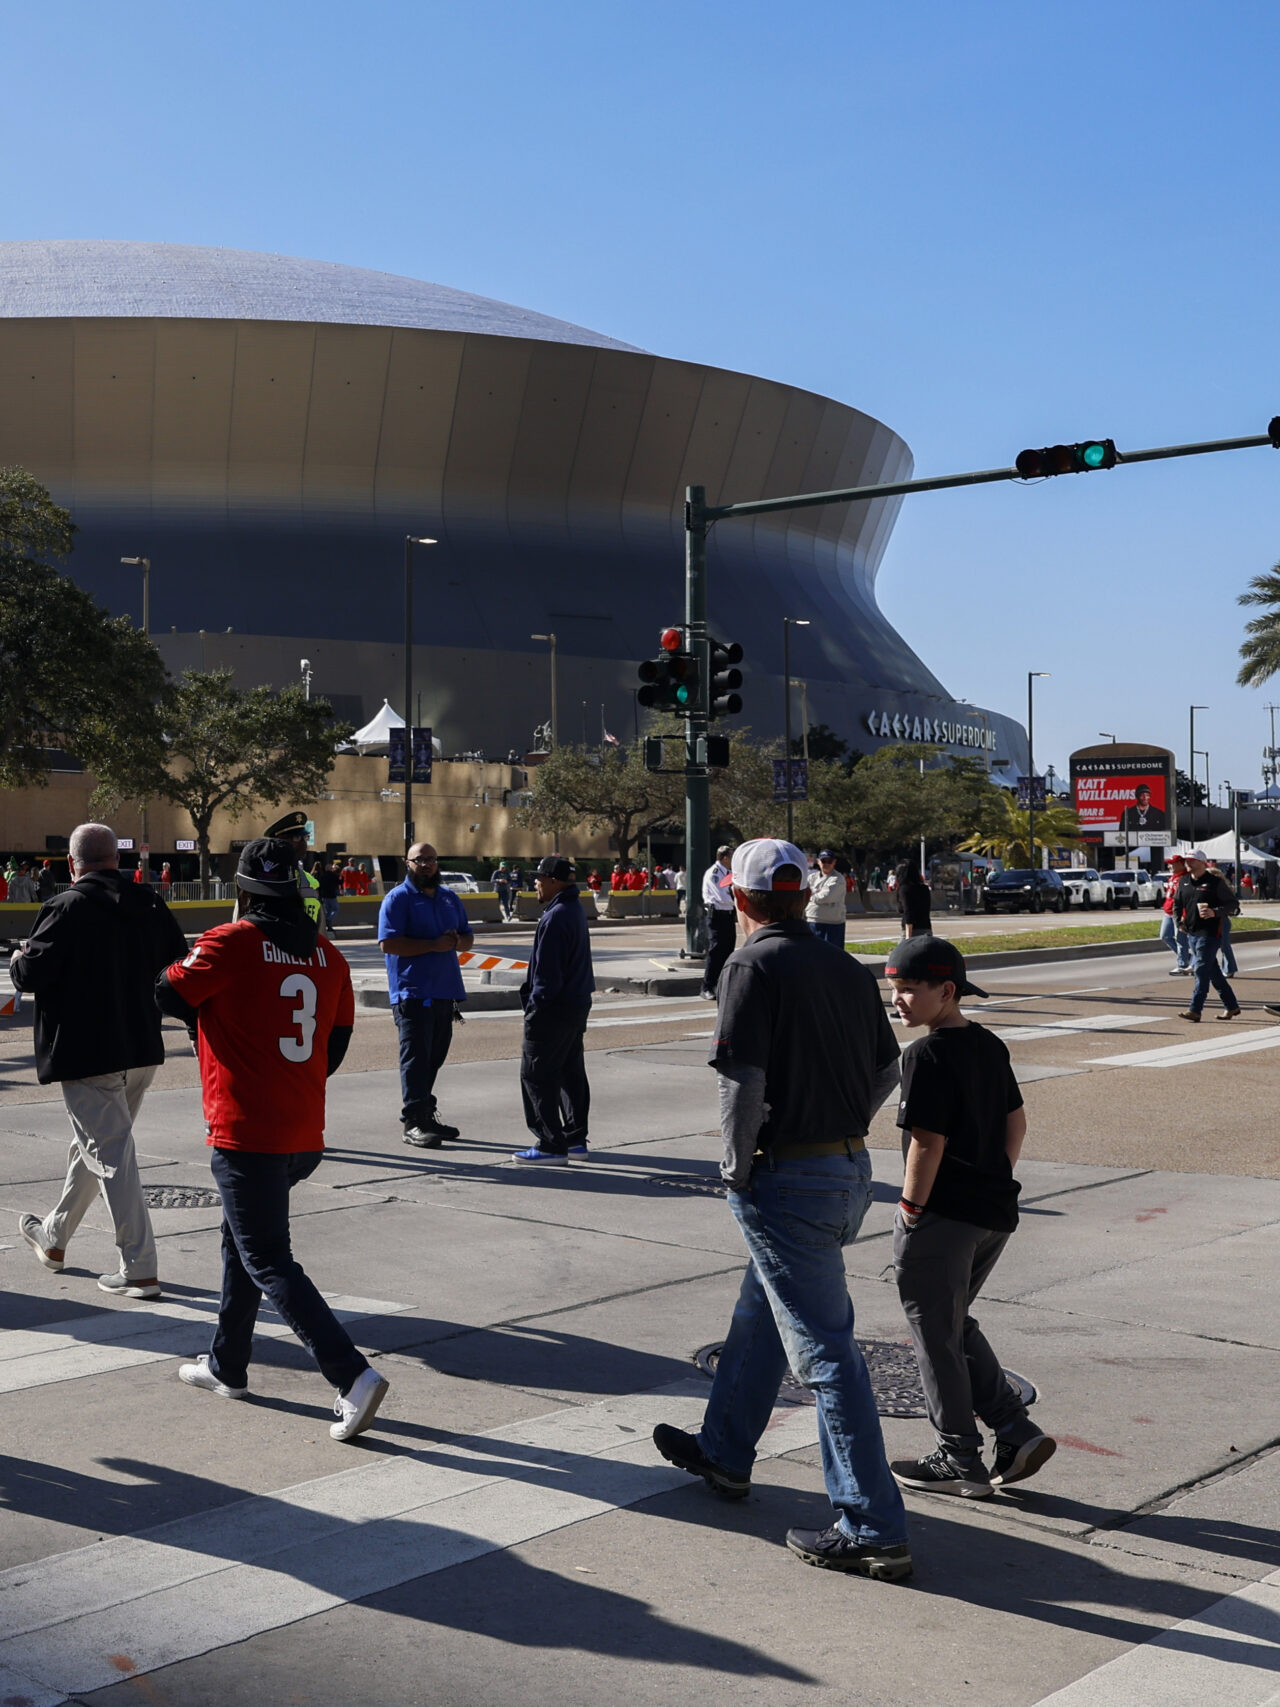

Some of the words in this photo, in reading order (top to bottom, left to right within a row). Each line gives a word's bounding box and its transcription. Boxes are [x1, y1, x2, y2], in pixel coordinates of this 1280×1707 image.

[867, 709, 941, 744] CAESARS
[941, 721, 997, 751] SUPERDOME
[1076, 763, 1116, 771] CAESARS
[1116, 762, 1163, 770] SUPERDOME
[1077, 778, 1107, 790] KATT
[1078, 789, 1137, 801] WILLIAMS
[1079, 807, 1098, 816] MAR
[178, 841, 193, 849] EXIT
[278, 973, 318, 1063] 3
